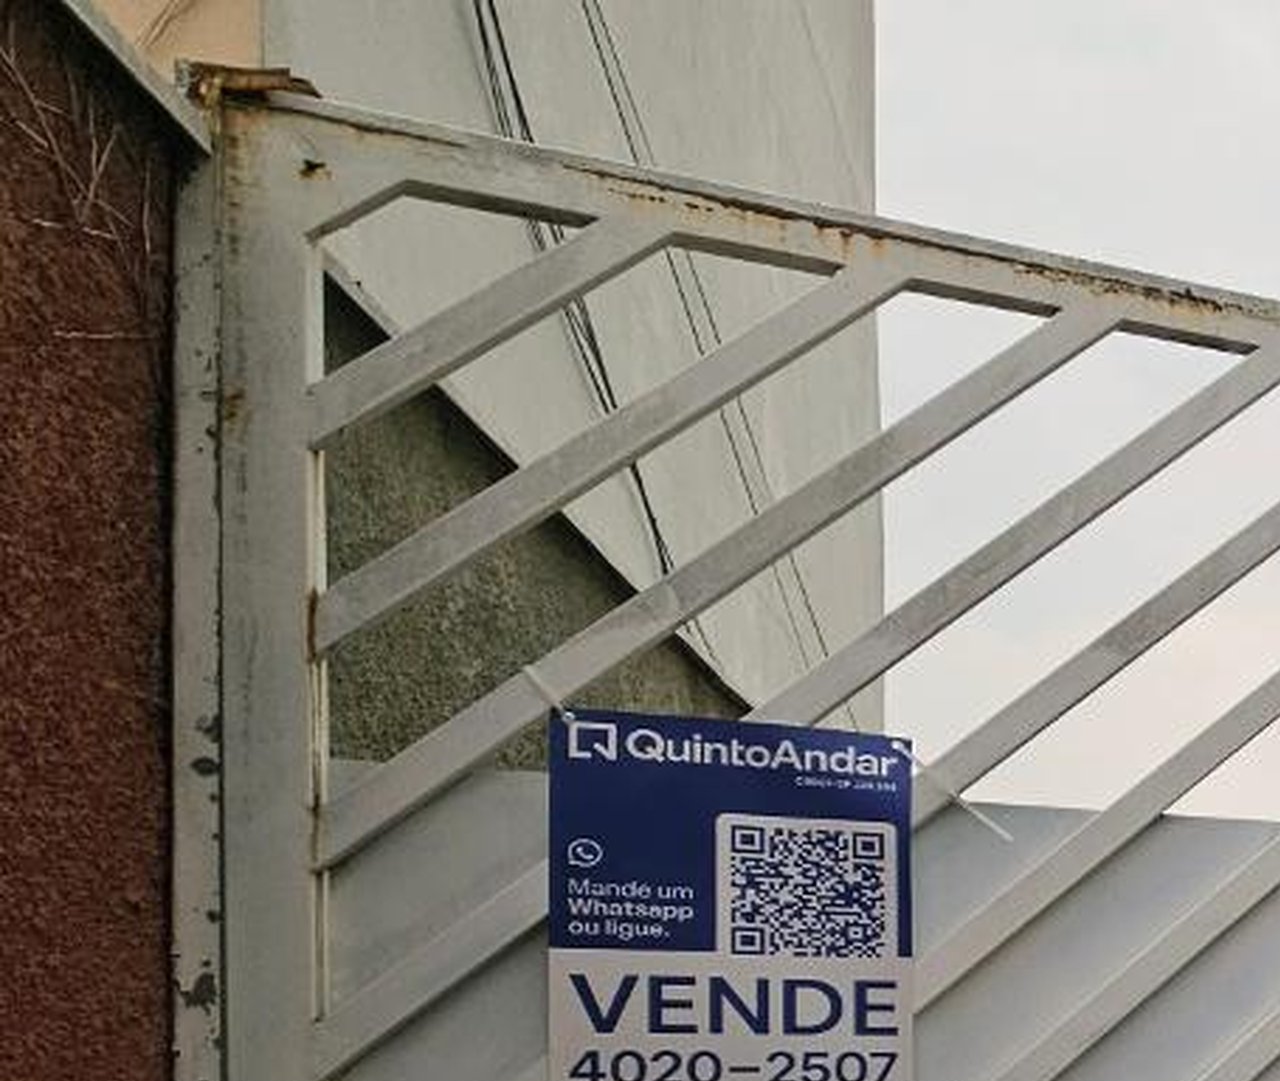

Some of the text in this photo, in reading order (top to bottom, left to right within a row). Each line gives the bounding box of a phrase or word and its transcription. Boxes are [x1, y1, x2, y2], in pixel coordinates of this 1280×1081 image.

[625, 729, 899, 777] QuintoAndar
[567, 878, 694, 899] Mande um
[567, 897, 694, 921] Whatsapp
[568, 919, 670, 941] ou ligue.
[569, 973, 899, 1036] VENDE
